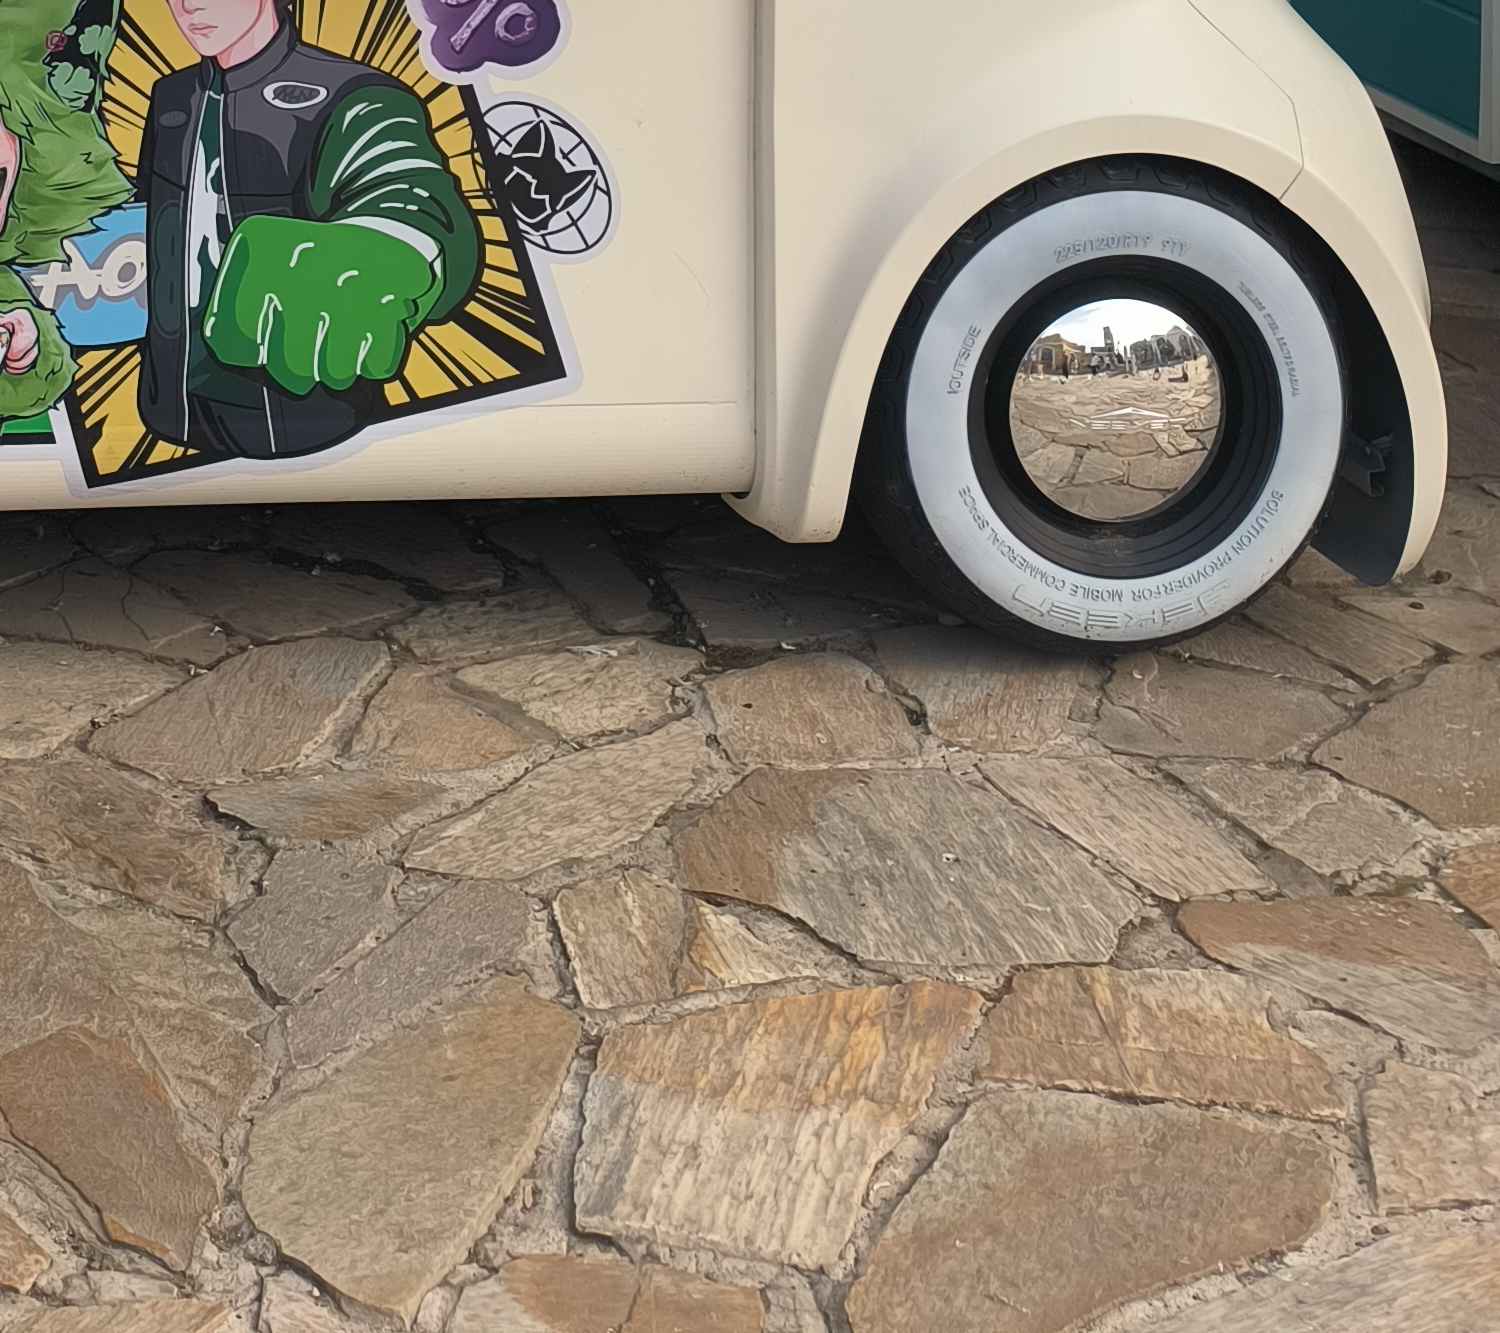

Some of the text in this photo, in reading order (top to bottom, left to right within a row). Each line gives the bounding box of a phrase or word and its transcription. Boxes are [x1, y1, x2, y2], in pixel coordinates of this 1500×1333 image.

[958, 485, 1284, 603] SOLUTION PROVIDER FOR MOBILE COMMERCIAL SPACE
